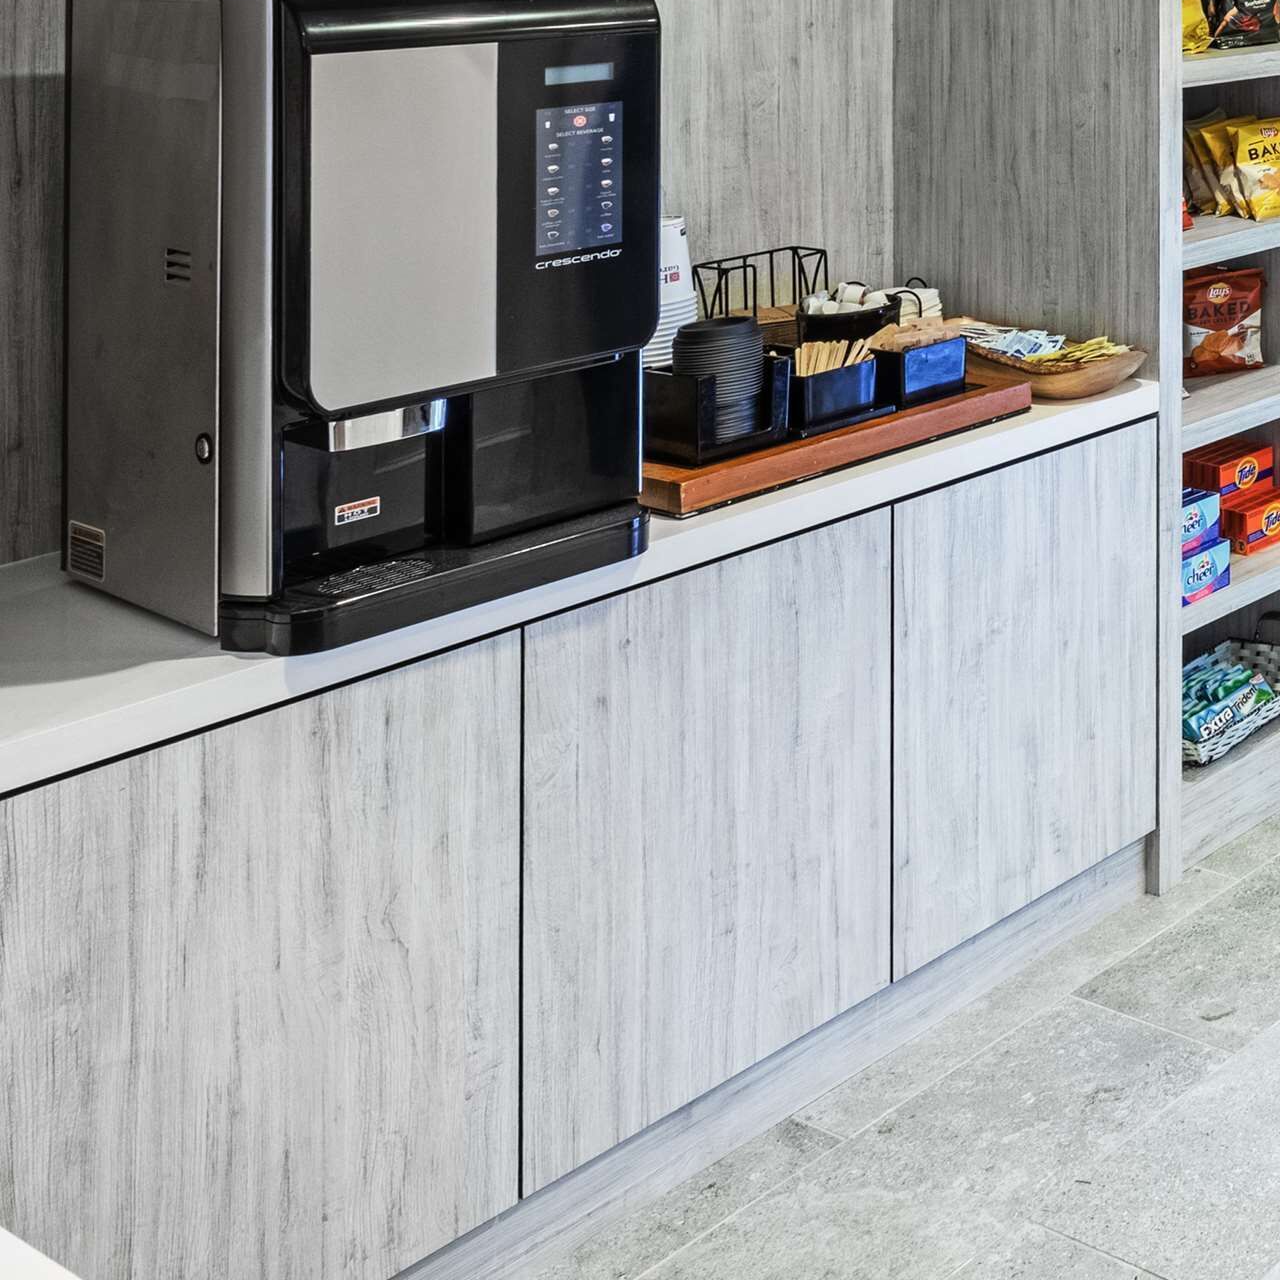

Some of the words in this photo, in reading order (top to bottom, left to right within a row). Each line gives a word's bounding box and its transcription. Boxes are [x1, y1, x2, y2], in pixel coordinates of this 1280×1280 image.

[535, 249, 622, 270] crescendo
[1207, 286, 1231, 300] Lay's
[1187, 300, 1250, 322] BAKED
[1237, 464, 1257, 483] Tide
